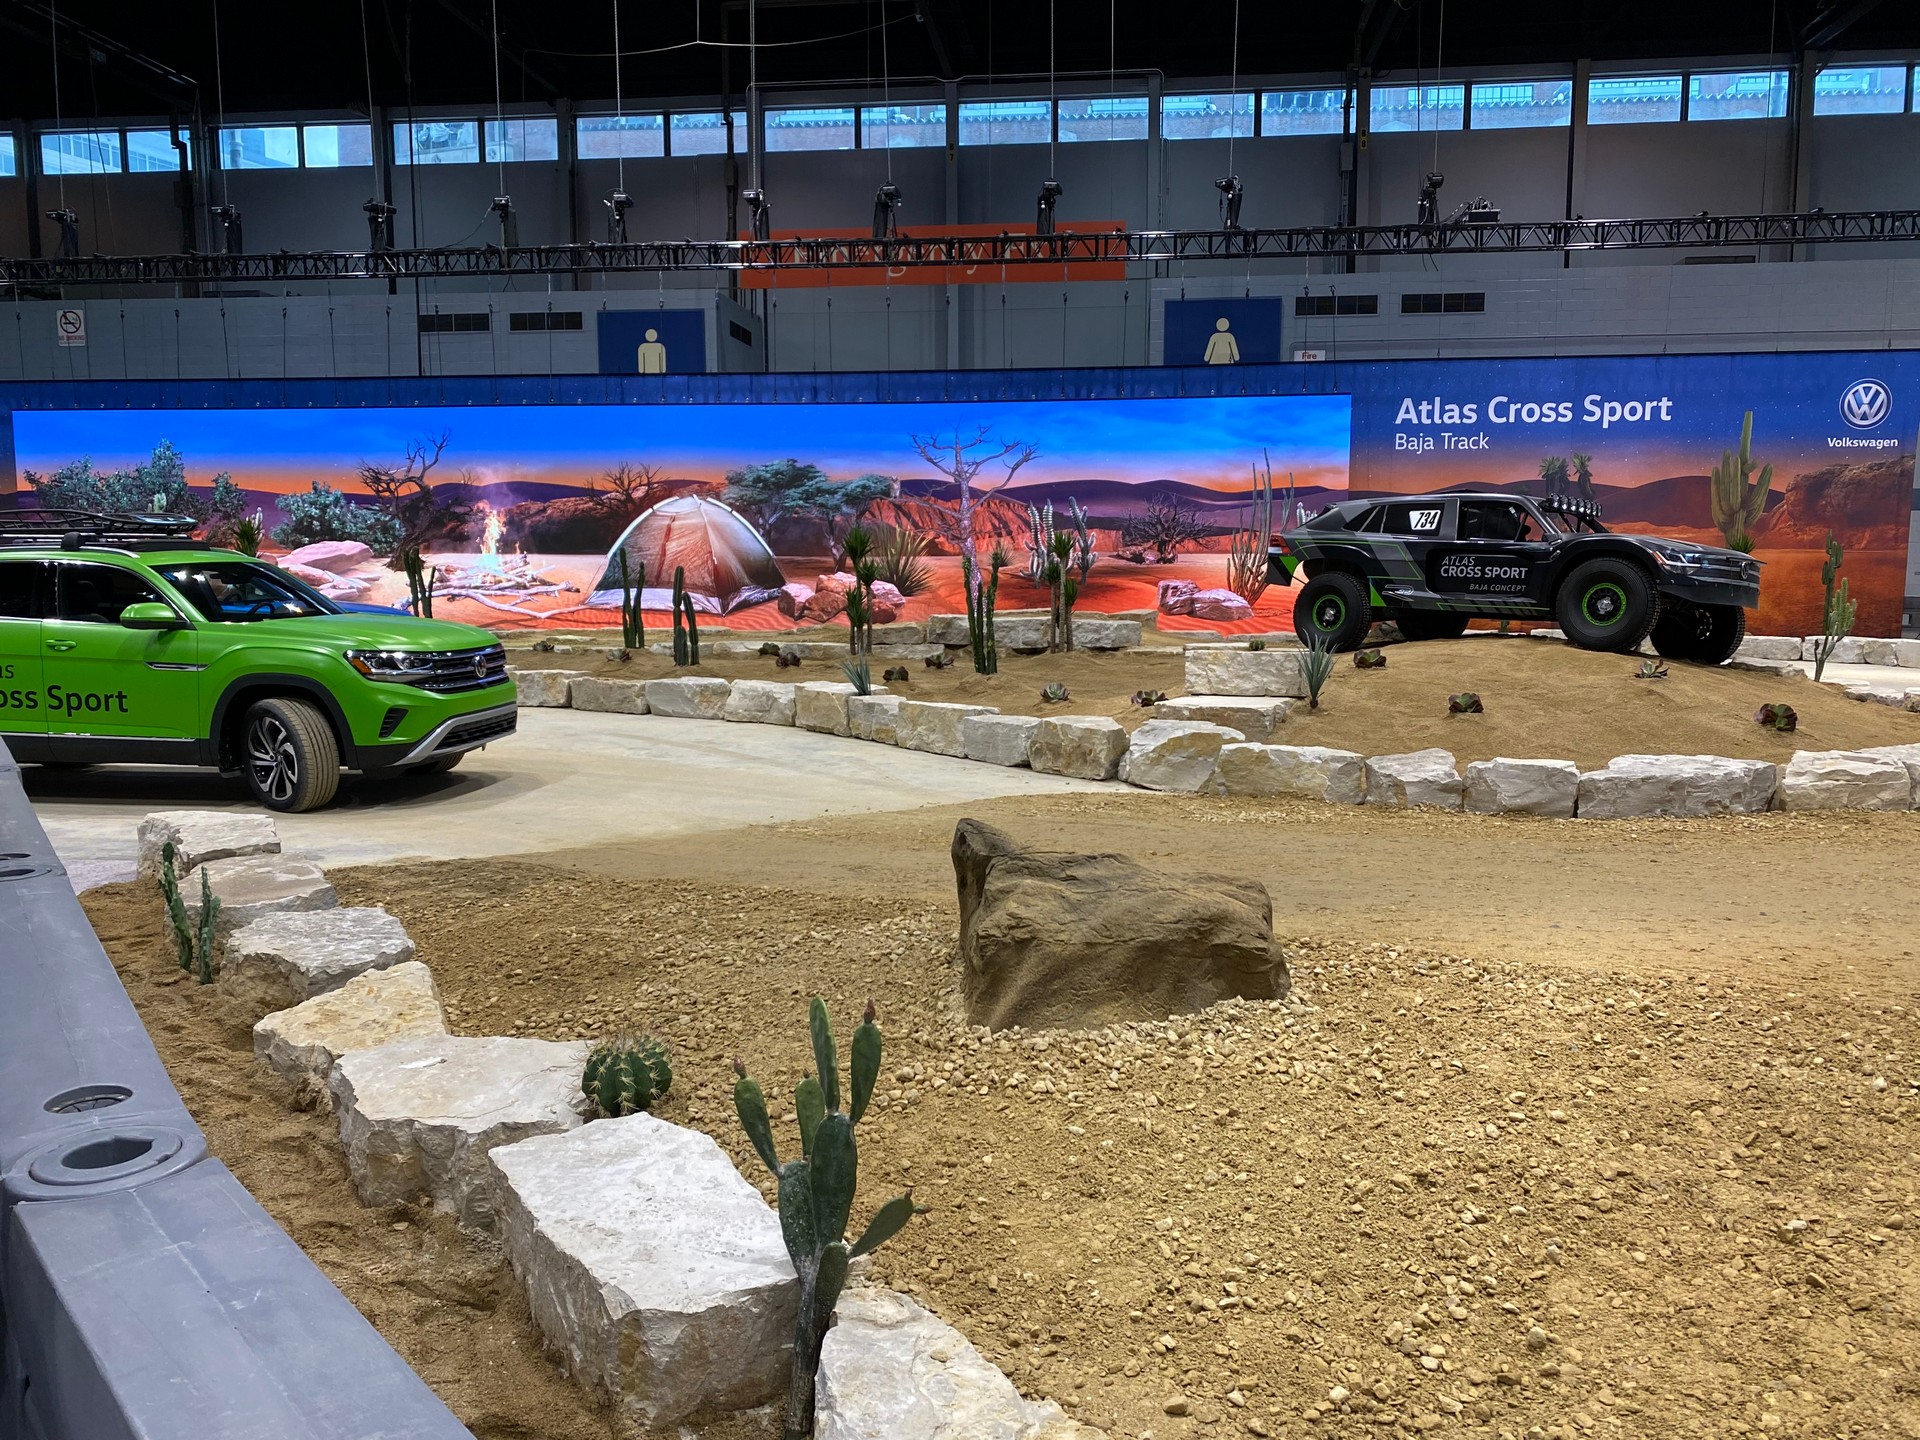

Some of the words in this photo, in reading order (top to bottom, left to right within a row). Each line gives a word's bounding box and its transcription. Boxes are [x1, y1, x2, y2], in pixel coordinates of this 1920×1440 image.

[1301, 351, 1318, 360] Fire
[1395, 396, 1478, 425] Atlas
[1488, 395, 1573, 424] Cross
[1582, 394, 1673, 429] Sport
[1395, 432, 1434, 454] Baja
[1441, 431, 1490, 450] Track
[1827, 437, 1899, 449] Volkswagen
[1414, 511, 1439, 529] 734
[1441, 556, 1476, 566] ATLAS
[1440, 565, 1482, 577] CROSS
[1484, 566, 1529, 579] SPORT
[1469, 583, 1489, 591] BAJA
[1490, 584, 1527, 592] CONCEPT
[47, 684, 129, 718] Sport
